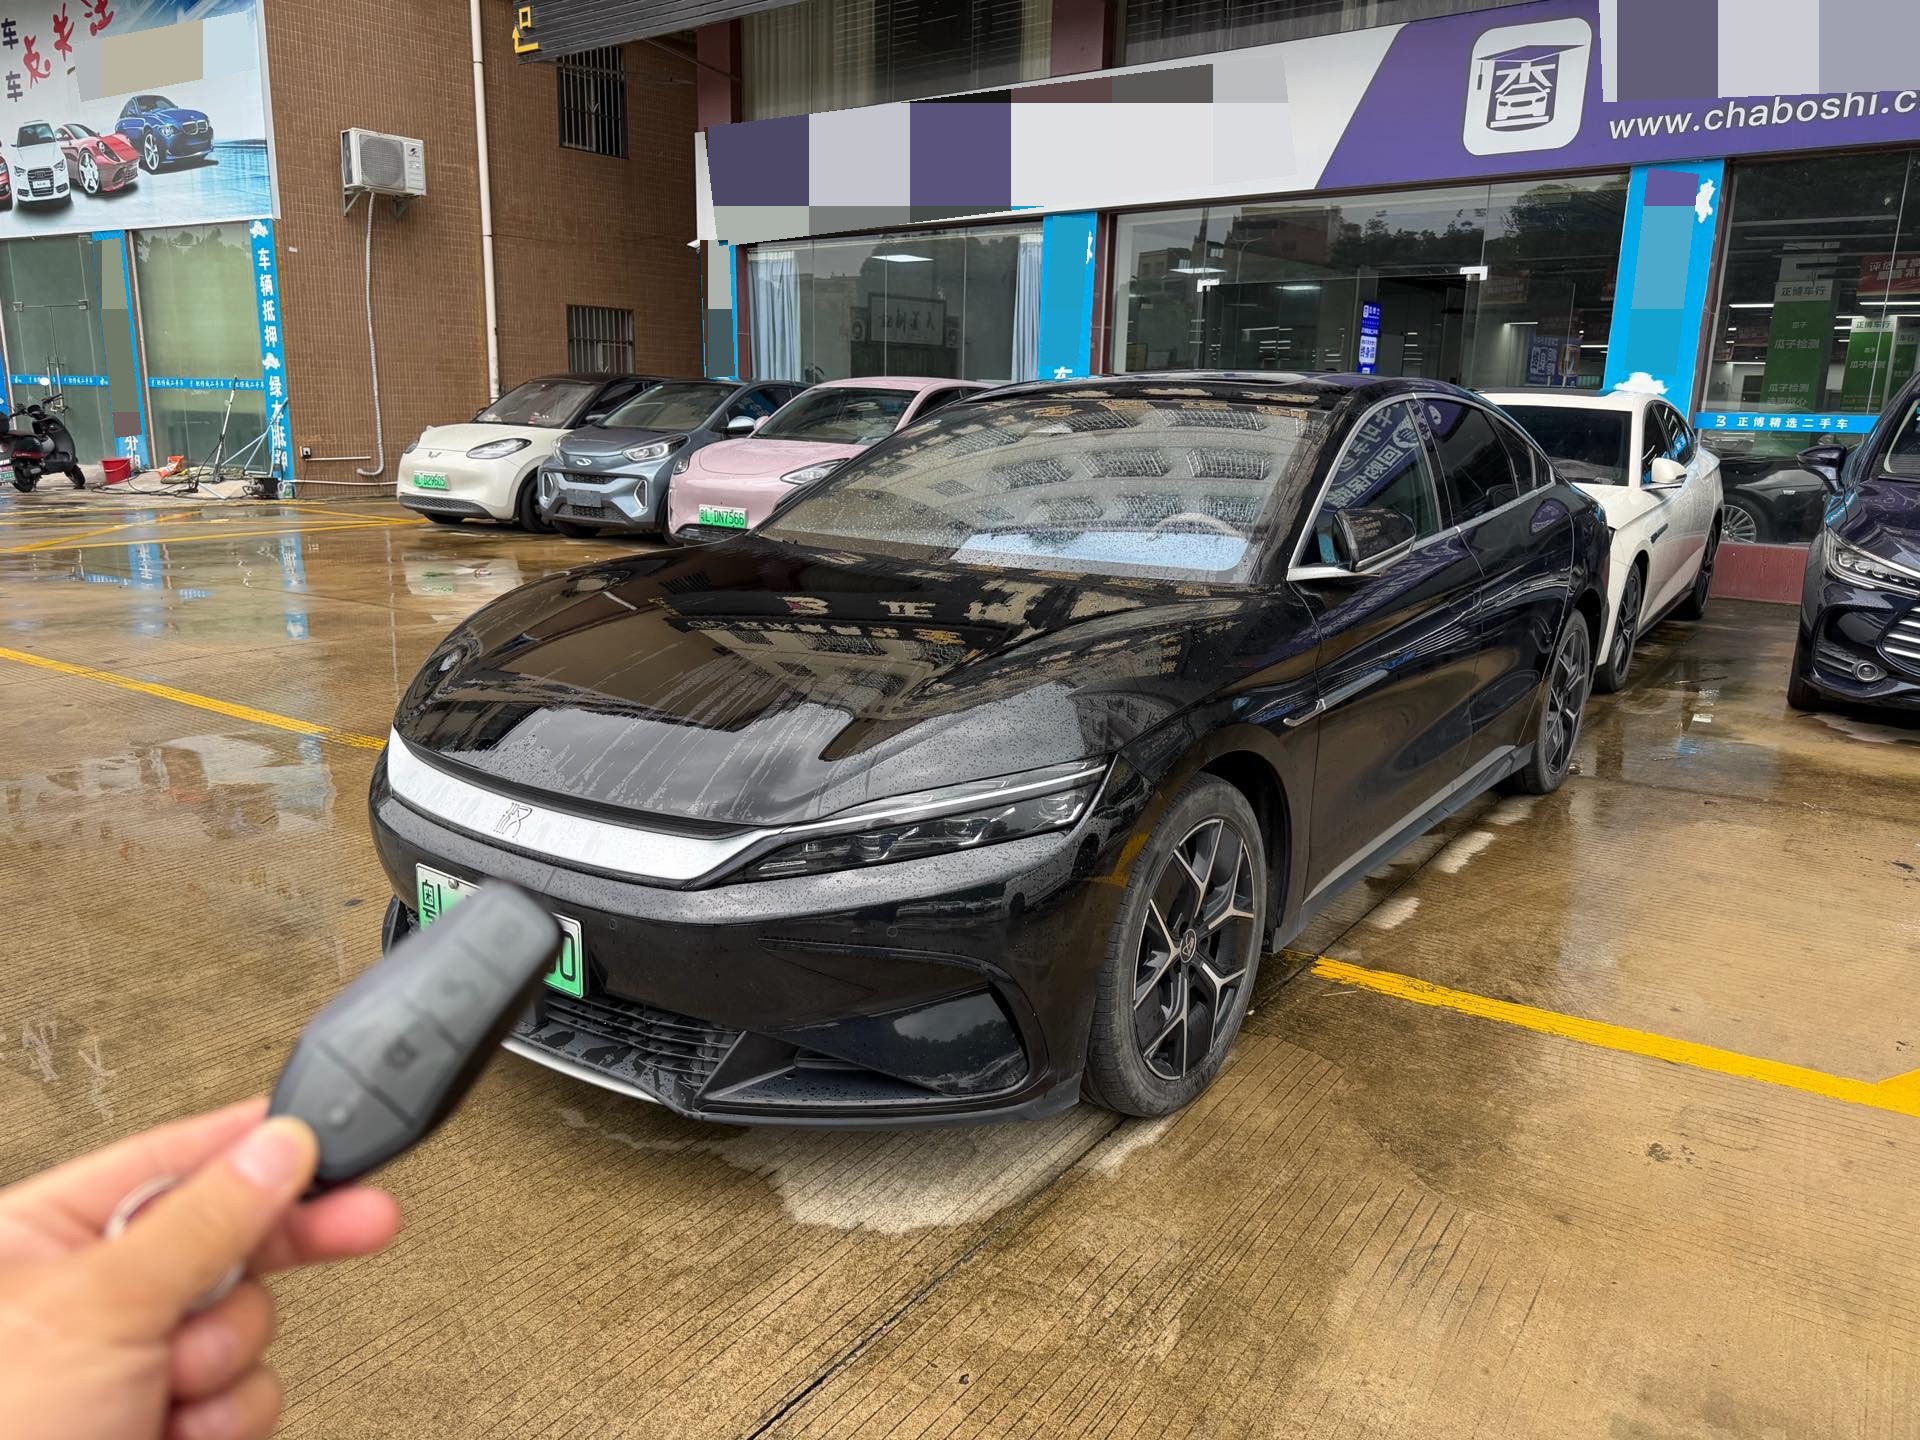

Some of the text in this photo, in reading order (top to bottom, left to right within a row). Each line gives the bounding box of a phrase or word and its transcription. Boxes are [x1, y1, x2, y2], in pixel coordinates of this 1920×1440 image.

[1609, 89, 1920, 140] www.chaboshi.c
[257, 247, 278, 348] 车辆抵押
[1781, 286, 1827, 297] 正博车行
[1855, 320, 1892, 330] 正博车行
[1736, 415, 1849, 430] 正博精选二手车
